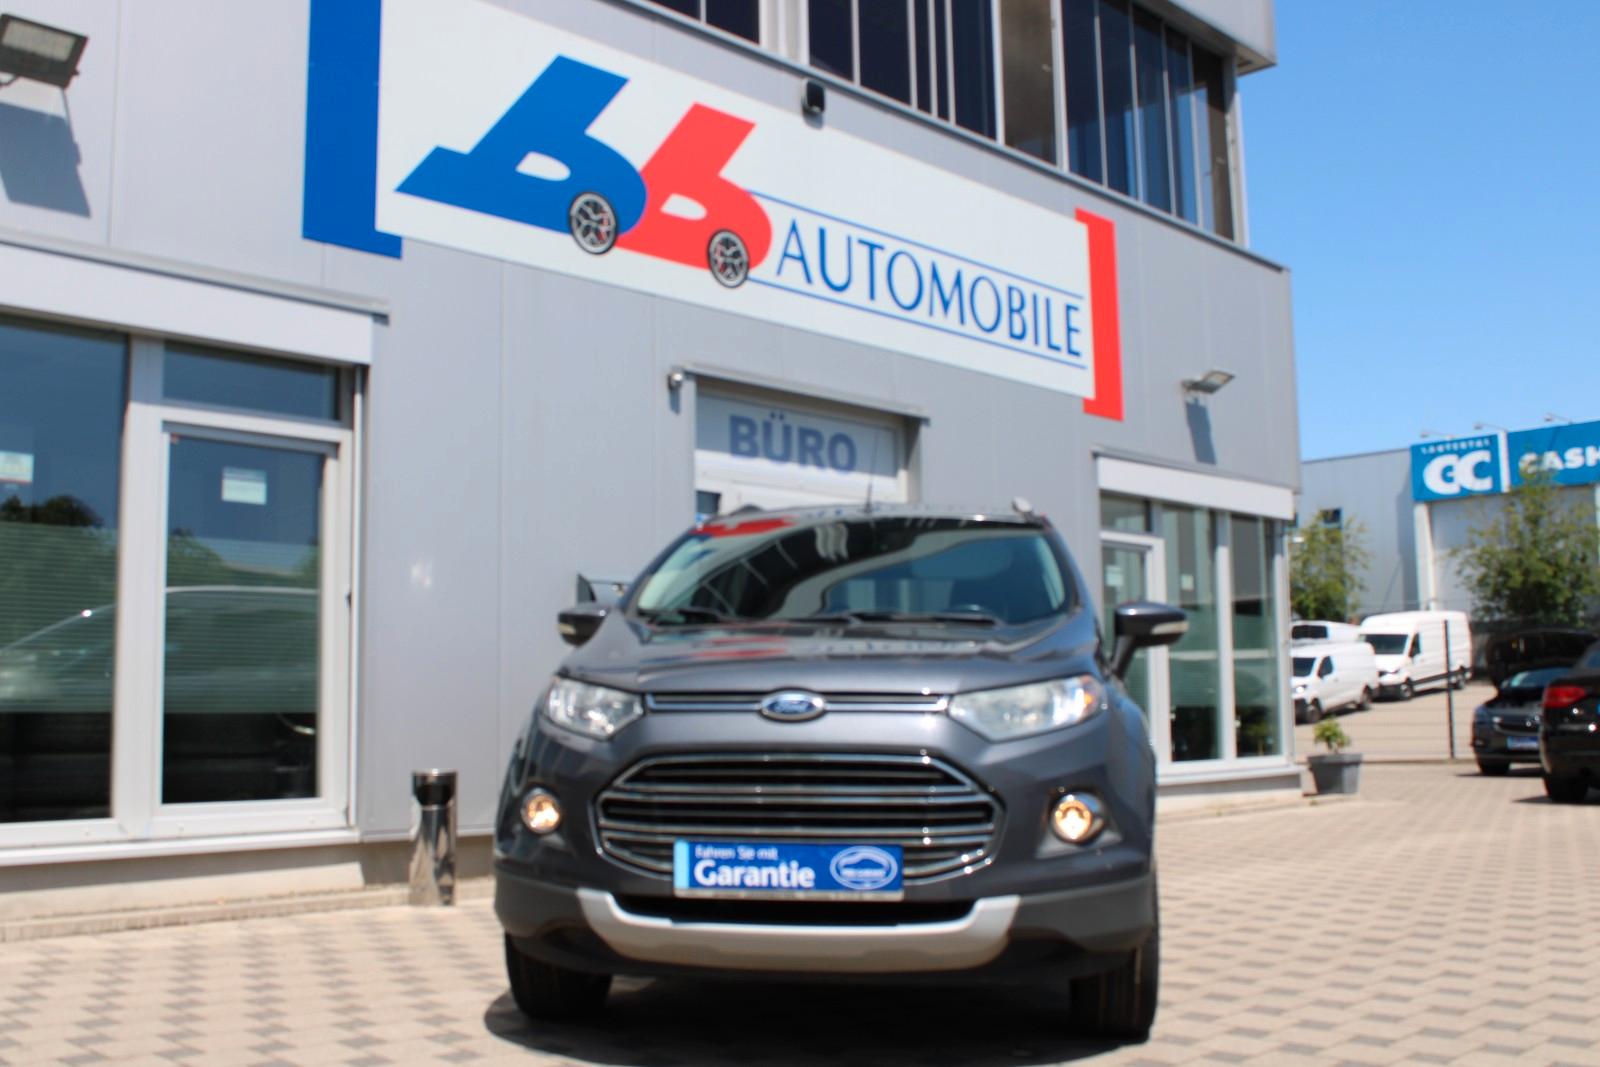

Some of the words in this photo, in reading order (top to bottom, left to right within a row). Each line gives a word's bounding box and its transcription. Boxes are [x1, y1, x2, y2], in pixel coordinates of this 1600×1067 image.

[776, 218, 1081, 357] AUTOMOBILE
[729, 412, 857, 472] BÜRO
[693, 859, 816, 889] Garantie
